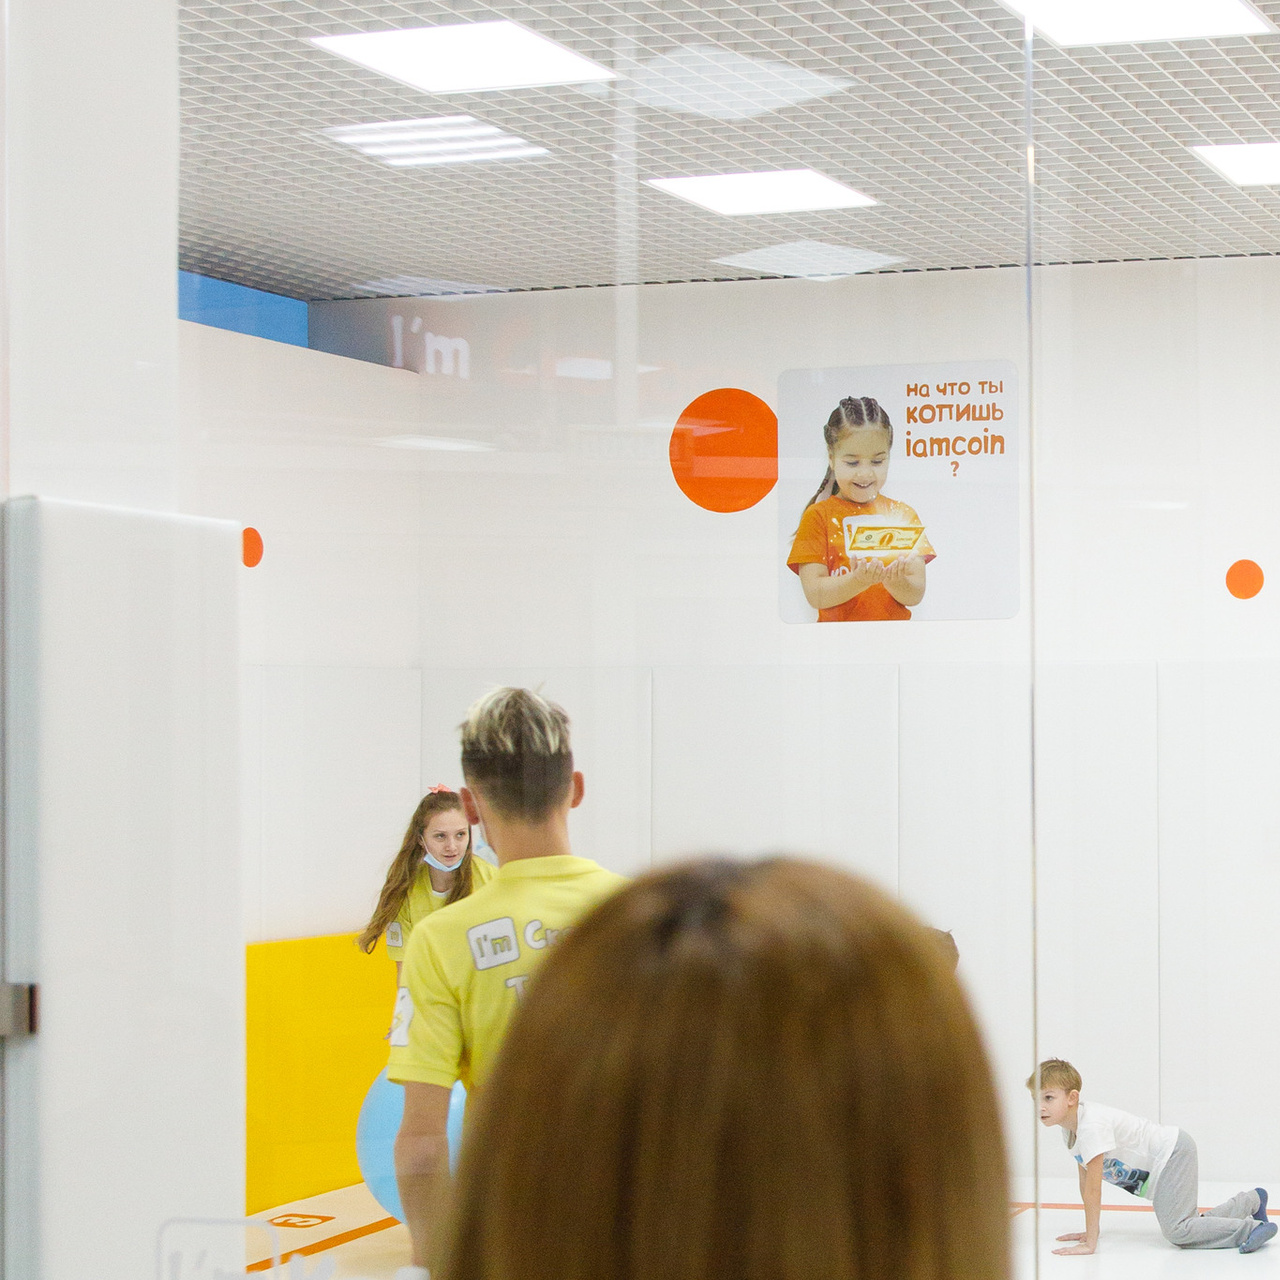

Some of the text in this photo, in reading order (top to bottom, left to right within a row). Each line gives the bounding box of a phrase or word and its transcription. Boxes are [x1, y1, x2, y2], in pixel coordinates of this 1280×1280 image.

[906, 380, 1003, 398] на что ты
[906, 427, 1005, 458] iamcoin
[950, 460, 960, 477] ?
[475, 934, 512, 958] I'm
